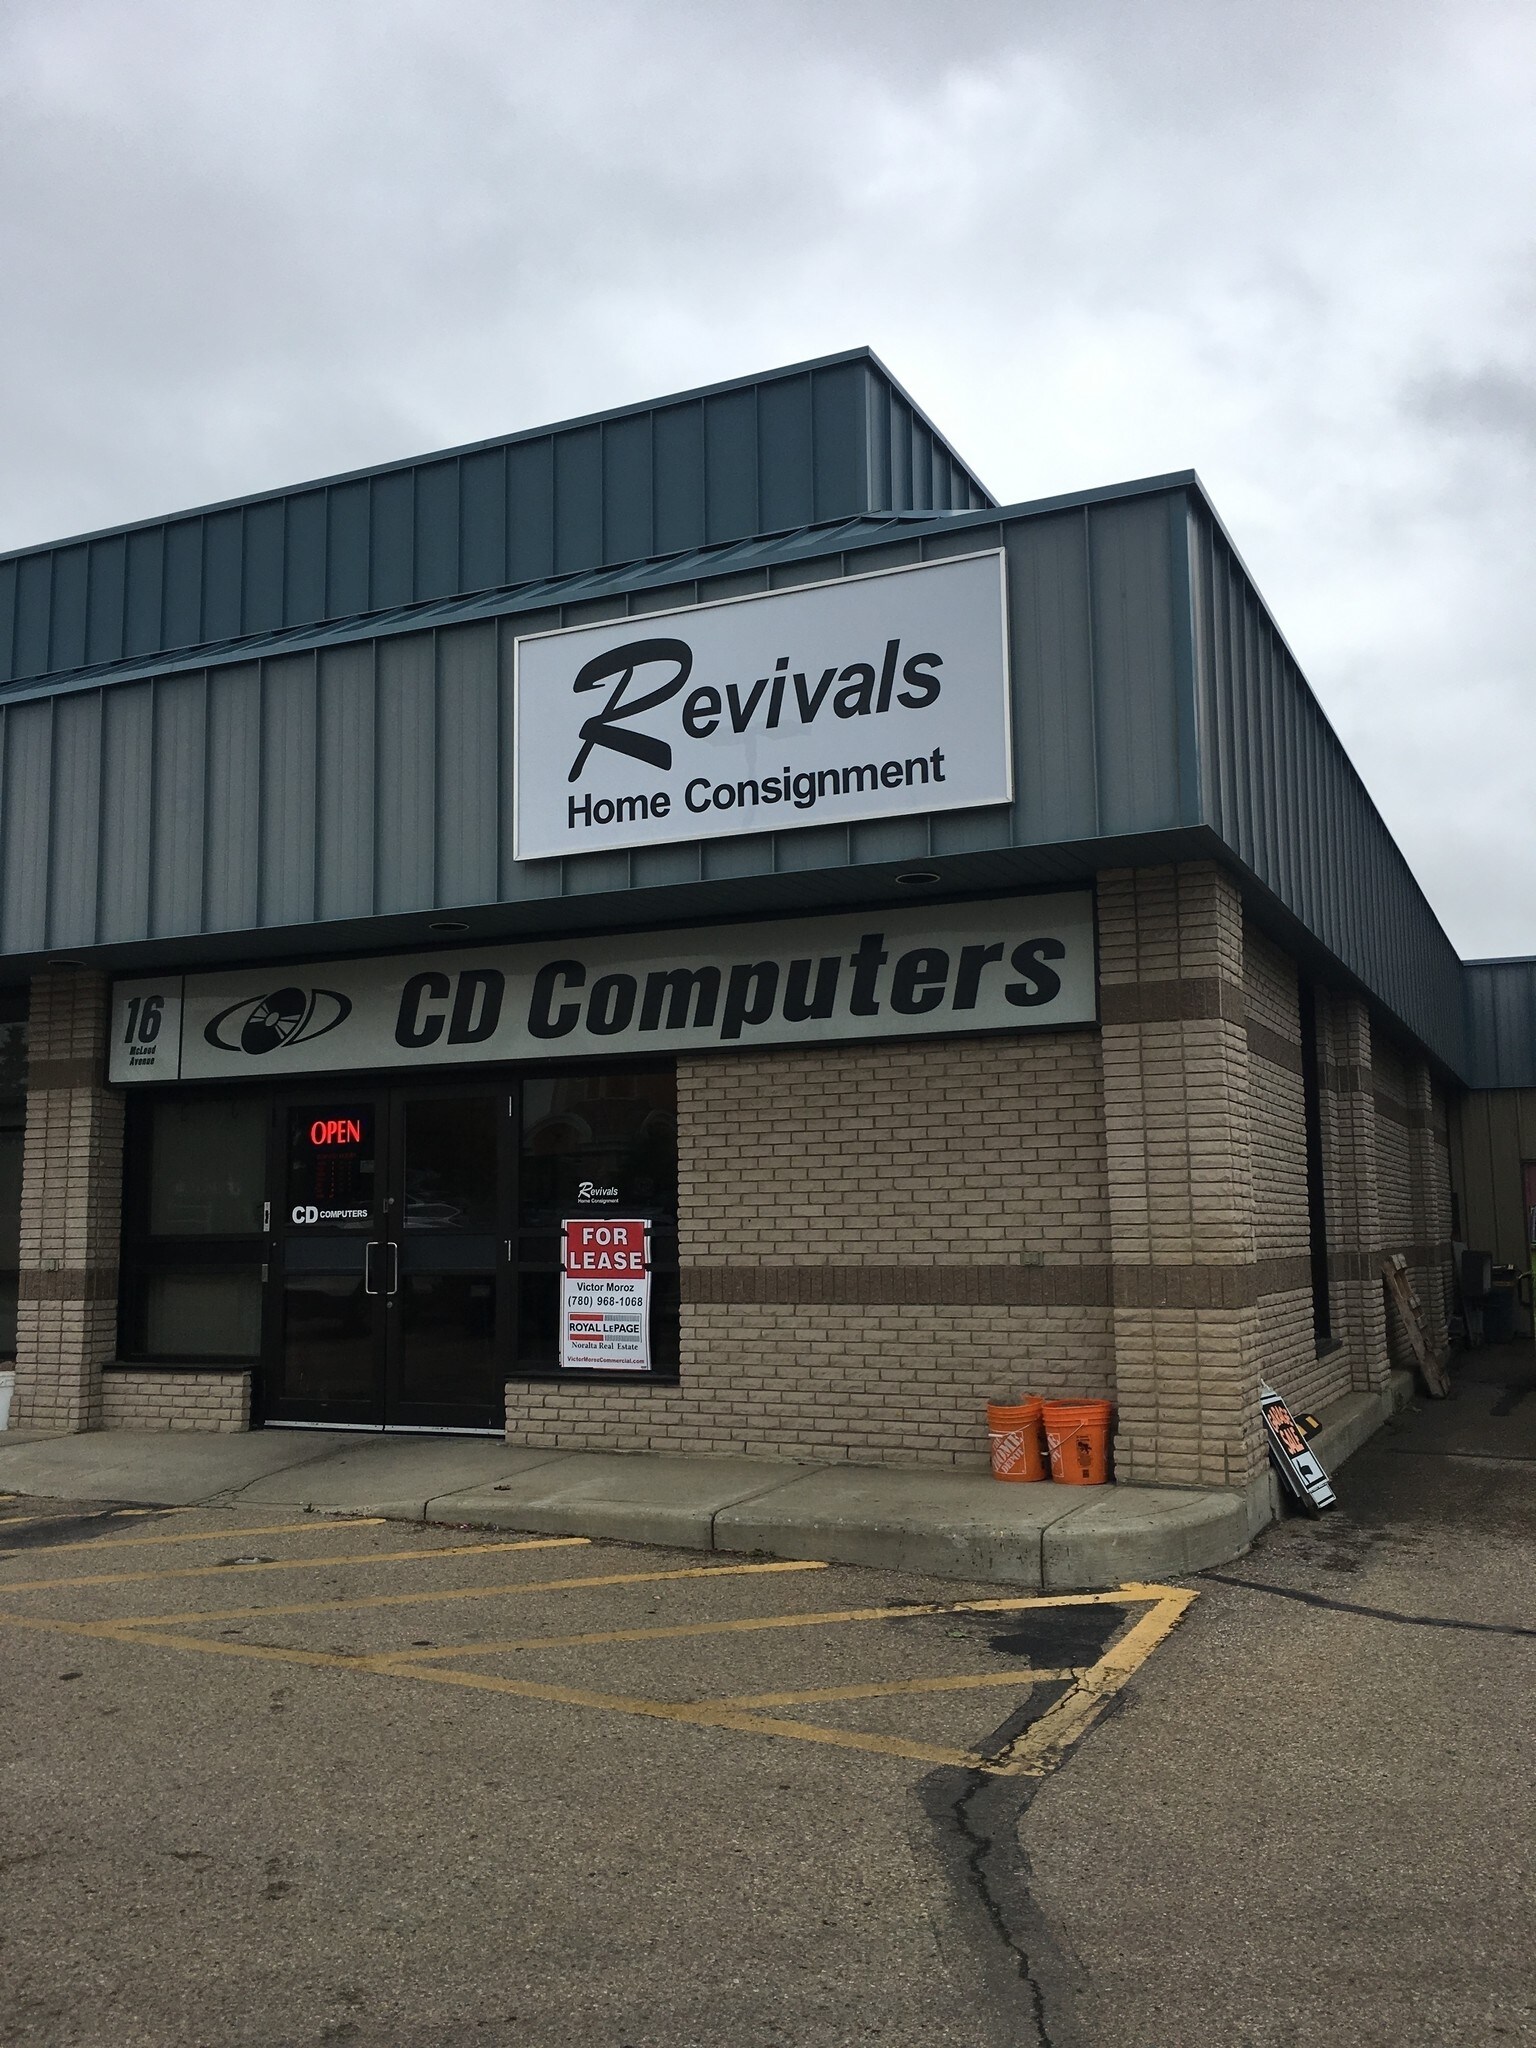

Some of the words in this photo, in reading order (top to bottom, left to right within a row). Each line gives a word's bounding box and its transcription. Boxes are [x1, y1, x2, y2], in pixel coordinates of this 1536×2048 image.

[568, 637, 944, 782] Revivals
[568, 790, 671, 828] Home
[684, 747, 946, 813] Consignment
[394, 969, 505, 1048] CD
[527, 933, 1066, 1039] Computers
[124, 995, 165, 1043] 16
[129, 1045, 157, 1055] McLeod
[129, 1057, 155, 1066] Avenue
[310, 1119, 360, 1145] OPEN
[577, 1181, 619, 1199] Revivals
[292, 1206, 319, 1224] CD
[319, 1209, 368, 1218] COMPUTERS
[582, 1227, 628, 1246] FOR
[570, 1251, 643, 1270] LEASE
[576, 1282, 604, 1292] Victor
[606, 1282, 634, 1292] Moroz
[567, 1296, 593, 1308] (780)
[597, 1296, 643, 1307] 968-1068
[569, 1323, 601, 1332] ROYAL
[599, 1342, 614, 1350] Real
[617, 1343, 639, 1351] Estate
[567, 1356, 645, 1364] VictorMorozCommercial.com
[1280, 1426, 1305, 1455] SALE
[992, 1432, 1024, 1471] HOME
[1001, 1447, 1024, 1474] DEPOT
